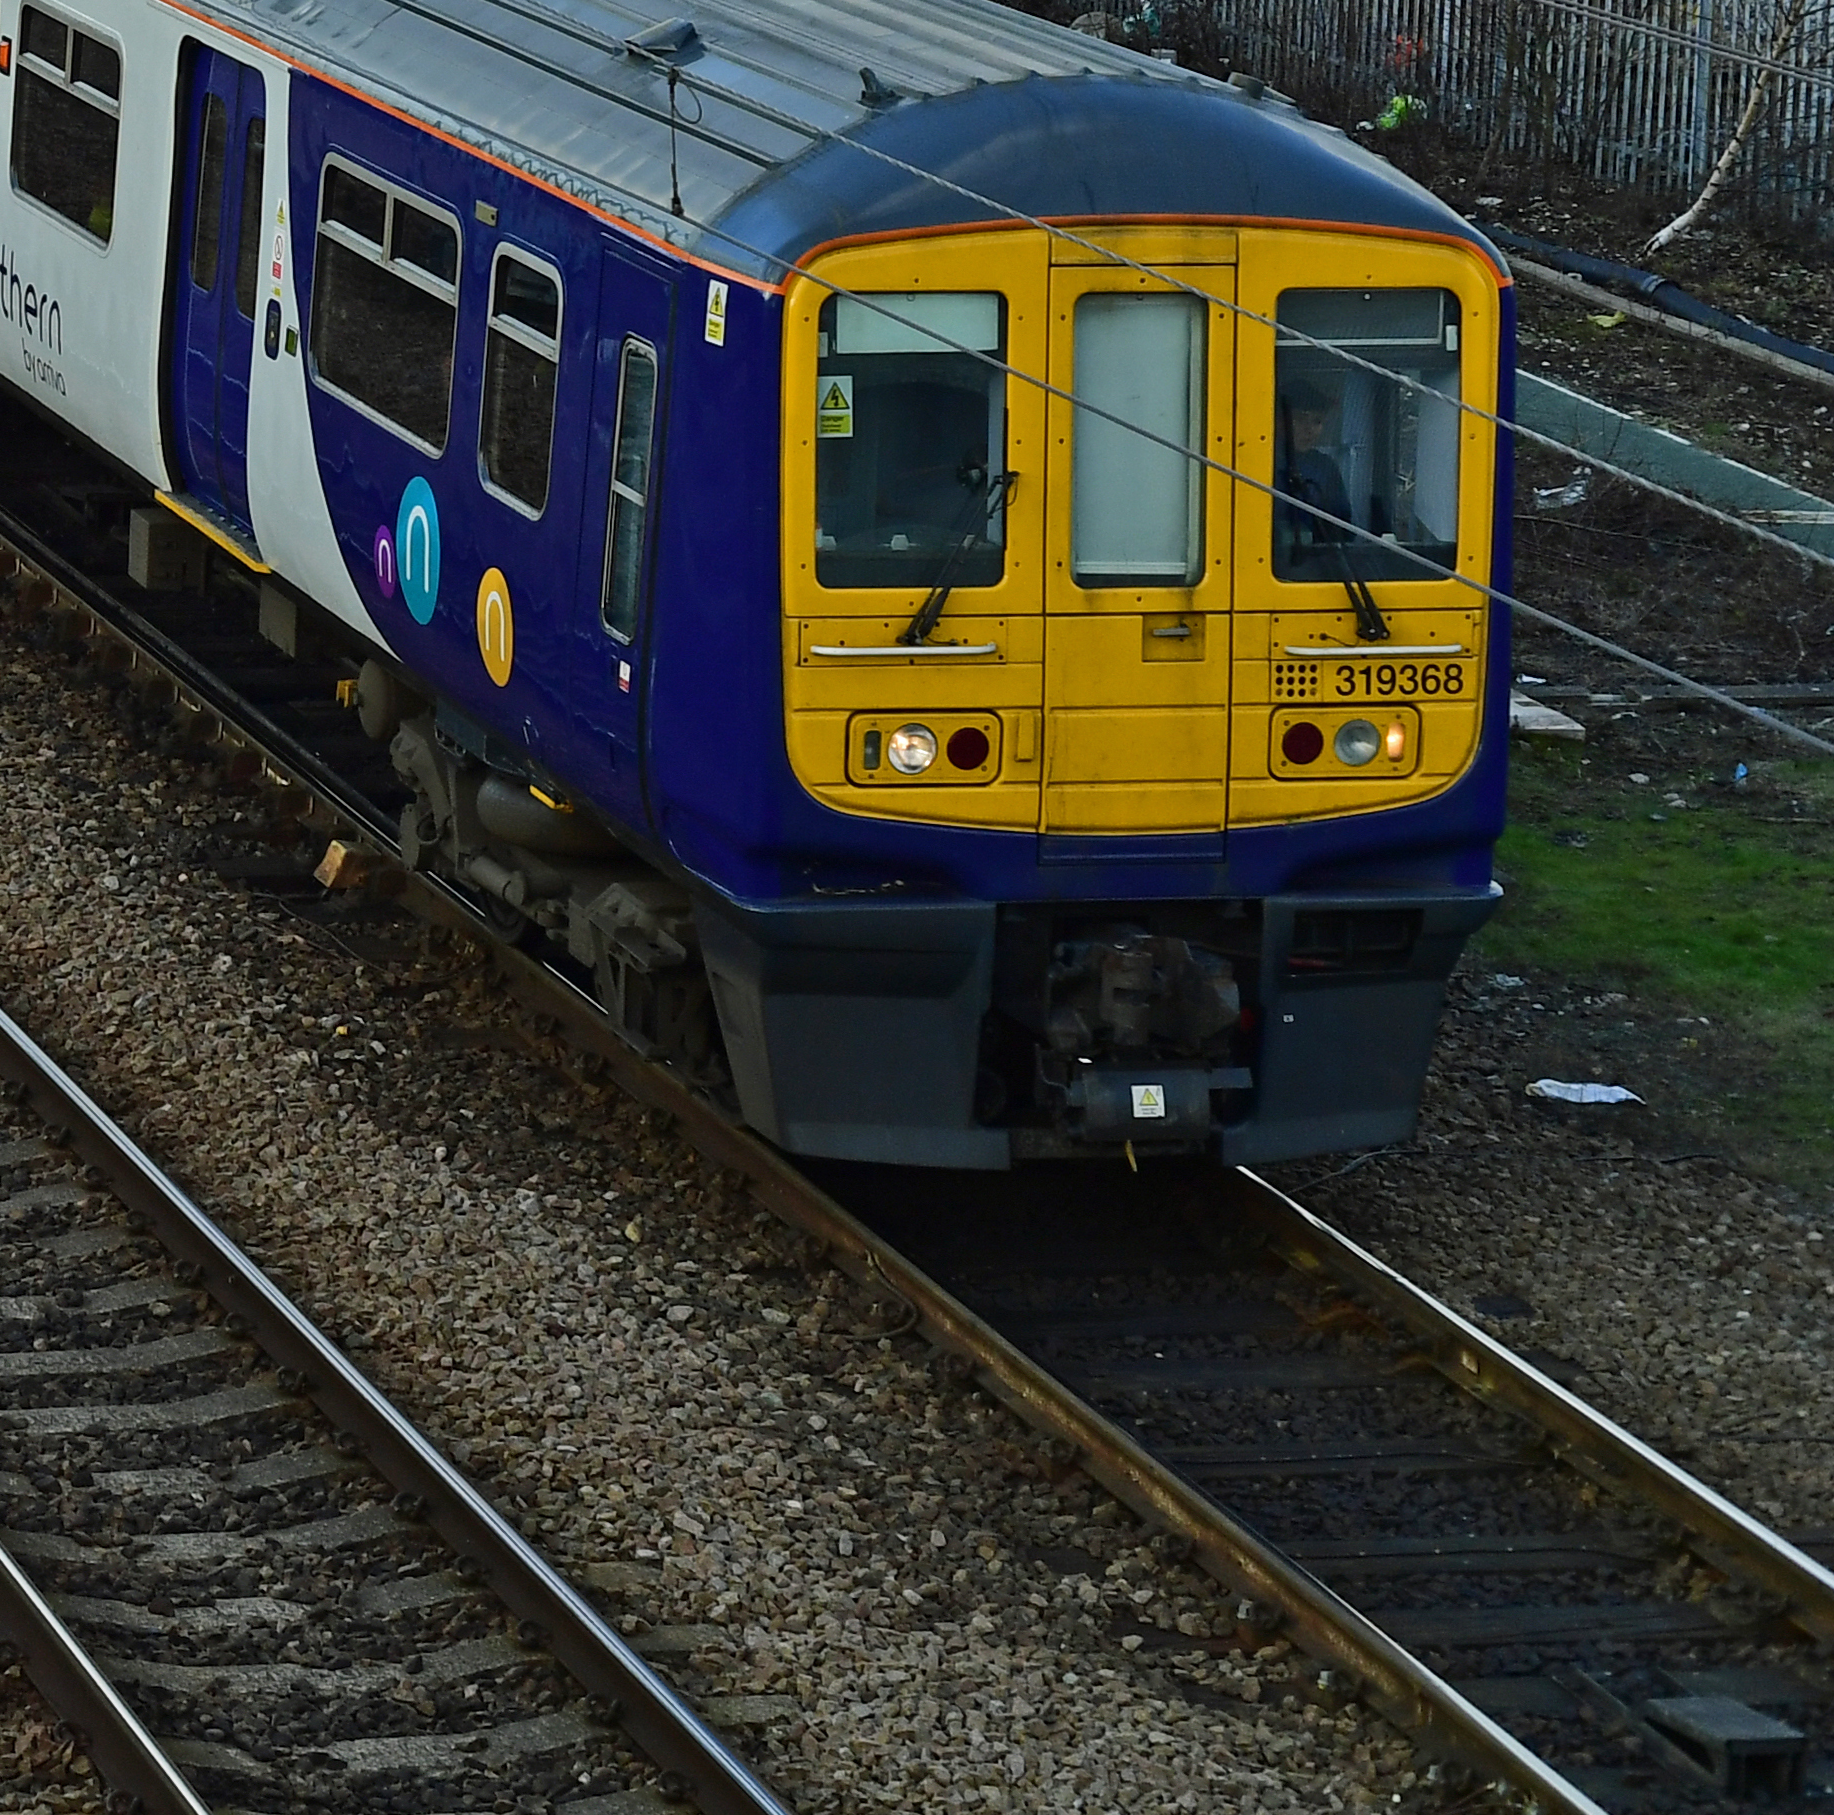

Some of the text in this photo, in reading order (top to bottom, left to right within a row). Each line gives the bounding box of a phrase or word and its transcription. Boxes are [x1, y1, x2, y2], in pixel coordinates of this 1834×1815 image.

[22, 337, 67, 397] by arriva
[1335, 663, 1464, 696] 319368
